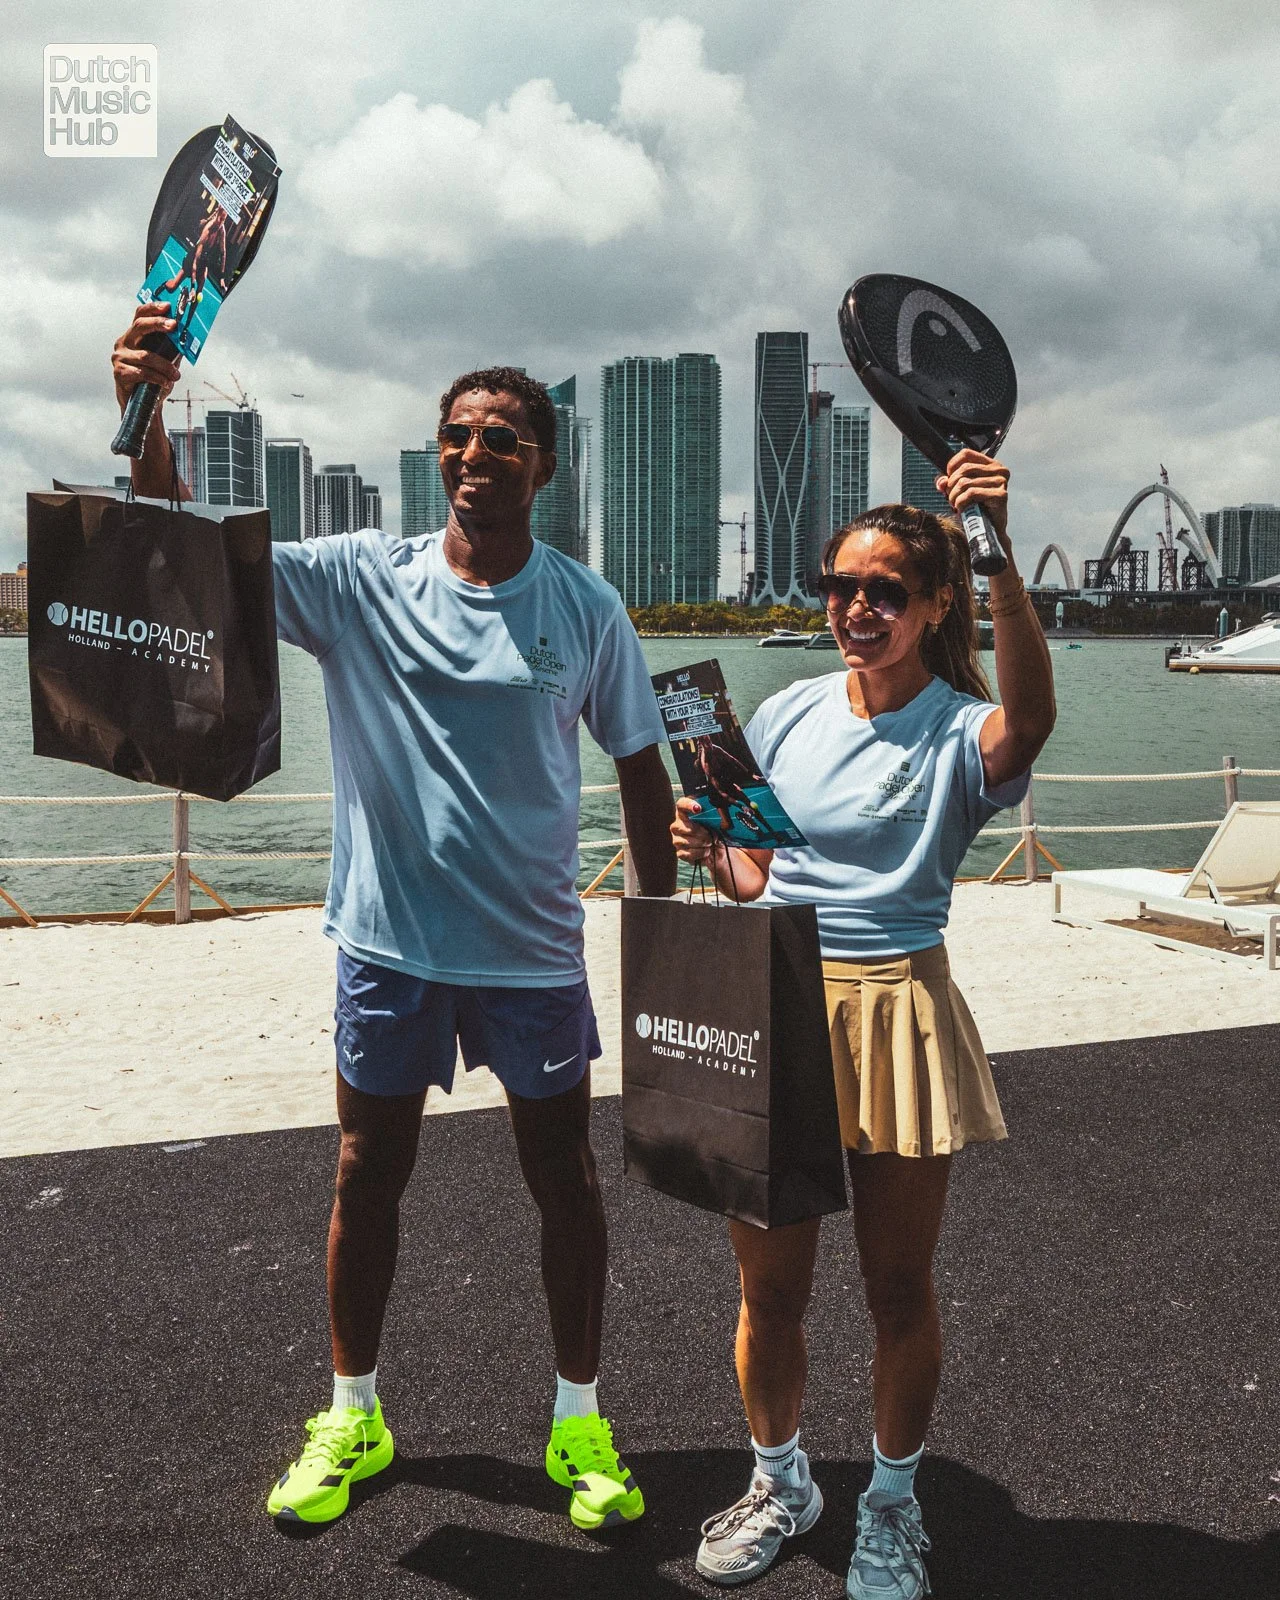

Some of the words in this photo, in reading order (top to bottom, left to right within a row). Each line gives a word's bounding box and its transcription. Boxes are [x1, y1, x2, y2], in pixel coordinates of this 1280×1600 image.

[243, 142, 254, 158] HELLO
[216, 138, 250, 181] CONGRATULATIONS!
[214, 156, 223, 171] WITH
[222, 166, 233, 180] YOUR
[236, 182, 250, 200] PRICE
[68, 634, 110, 650] HOLLAND
[132, 648, 210, 673] ACADEMY
[530, 646, 556, 660] Dutch
[517, 654, 542, 665] Padel
[544, 659, 566, 672] Open
[676, 674, 690, 682] HELLO
[659, 689, 698, 706] CONGRATULATIONS!
[667, 710, 677, 719] WITH
[678, 707, 689, 717] YOUR
[697, 701, 712, 712] PRICE
[653, 1045, 685, 1059] HOLLAND
[698, 1056, 756, 1078] ACADEMY
